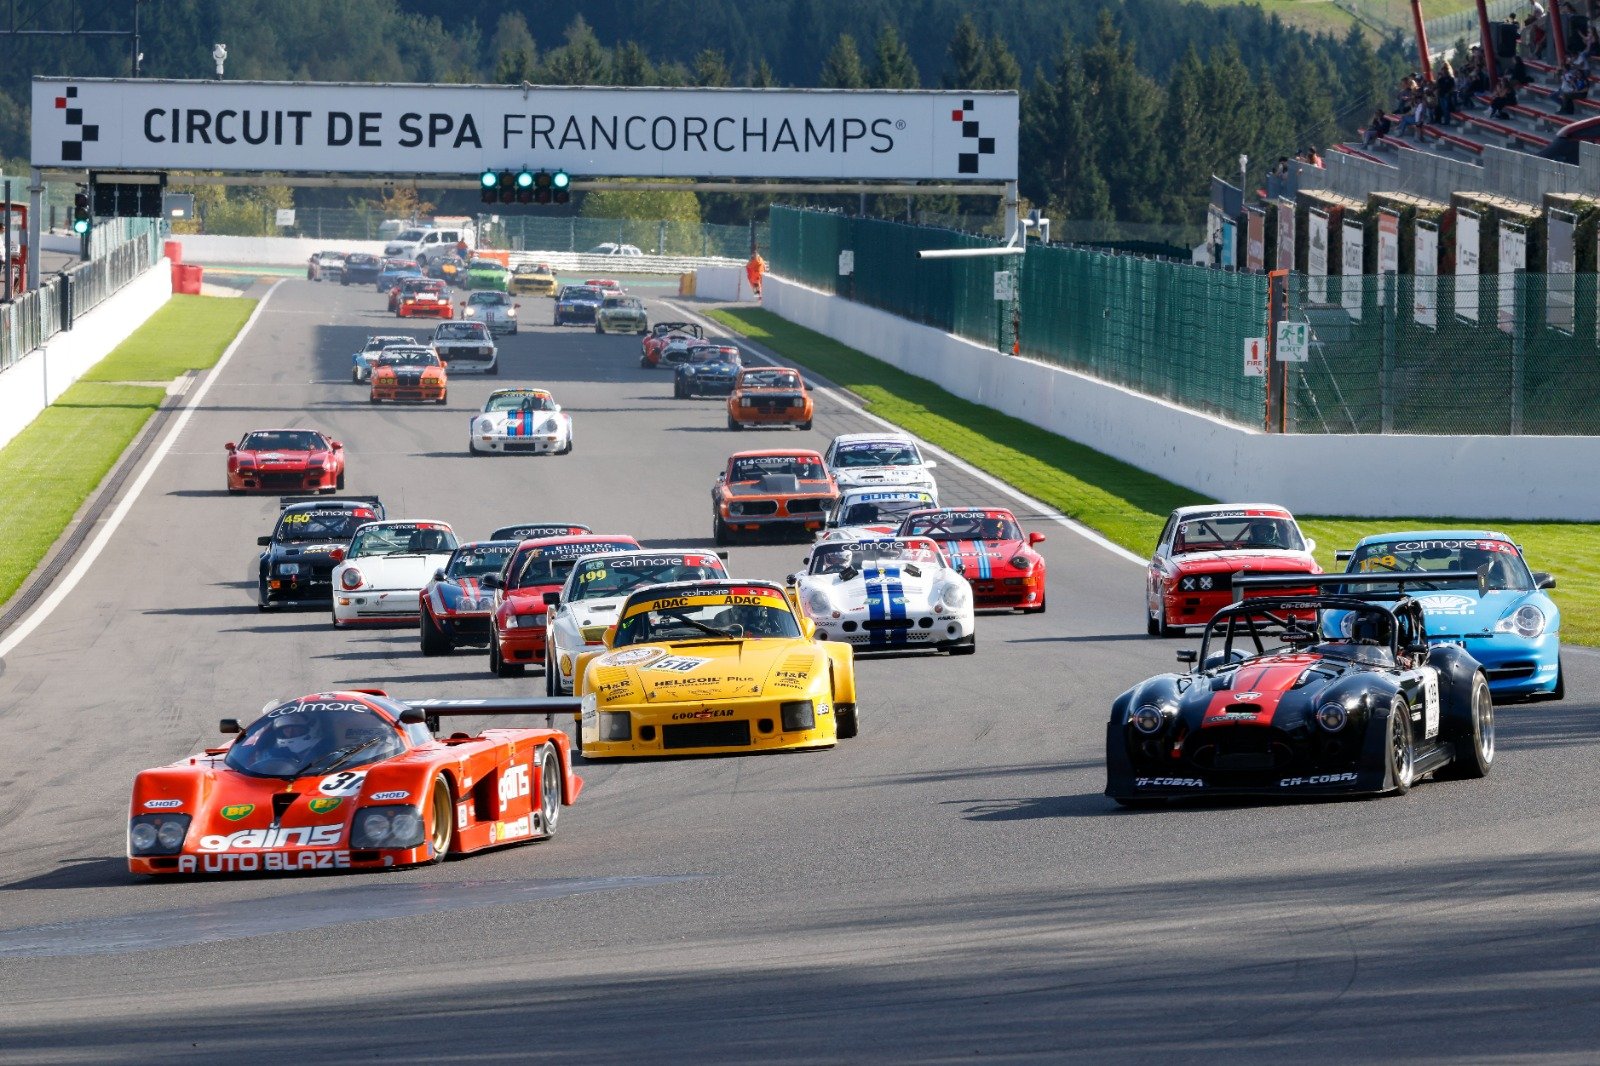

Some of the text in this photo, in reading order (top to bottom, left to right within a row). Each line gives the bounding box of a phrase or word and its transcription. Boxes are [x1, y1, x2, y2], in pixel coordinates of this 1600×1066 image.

[144, 109, 312, 145] CIRCUIT
[327, 111, 382, 147] DE
[398, 113, 483, 149] SPA
[736, 459, 755, 467] 114
[860, 493, 919, 501] BURTN
[304, 509, 353, 517] colmore
[931, 512, 986, 520] colmore
[283, 514, 310, 524] 450
[513, 528, 568, 537] colmore
[841, 541, 905, 551] colmore
[1395, 540, 1478, 550] colmore
[611, 556, 683, 568] colmore
[578, 569, 608, 584] 199
[681, 588, 730, 597] colmore
[652, 597, 689, 610] ADAC
[724, 595, 761, 605] ADAC
[656, 659, 701, 671] 518
[599, 680, 630, 692] H&R
[654, 677, 720, 687] HELICOIL
[267, 702, 369, 719] colmore
[1135, 777, 1203, 787] H-COBRA
[375, 791, 406, 799] SHOEI
[314, 797, 340, 809] BP
[225, 804, 252, 817] BP
[197, 822, 344, 853] gains
[264, 849, 351, 871] BLAZE
